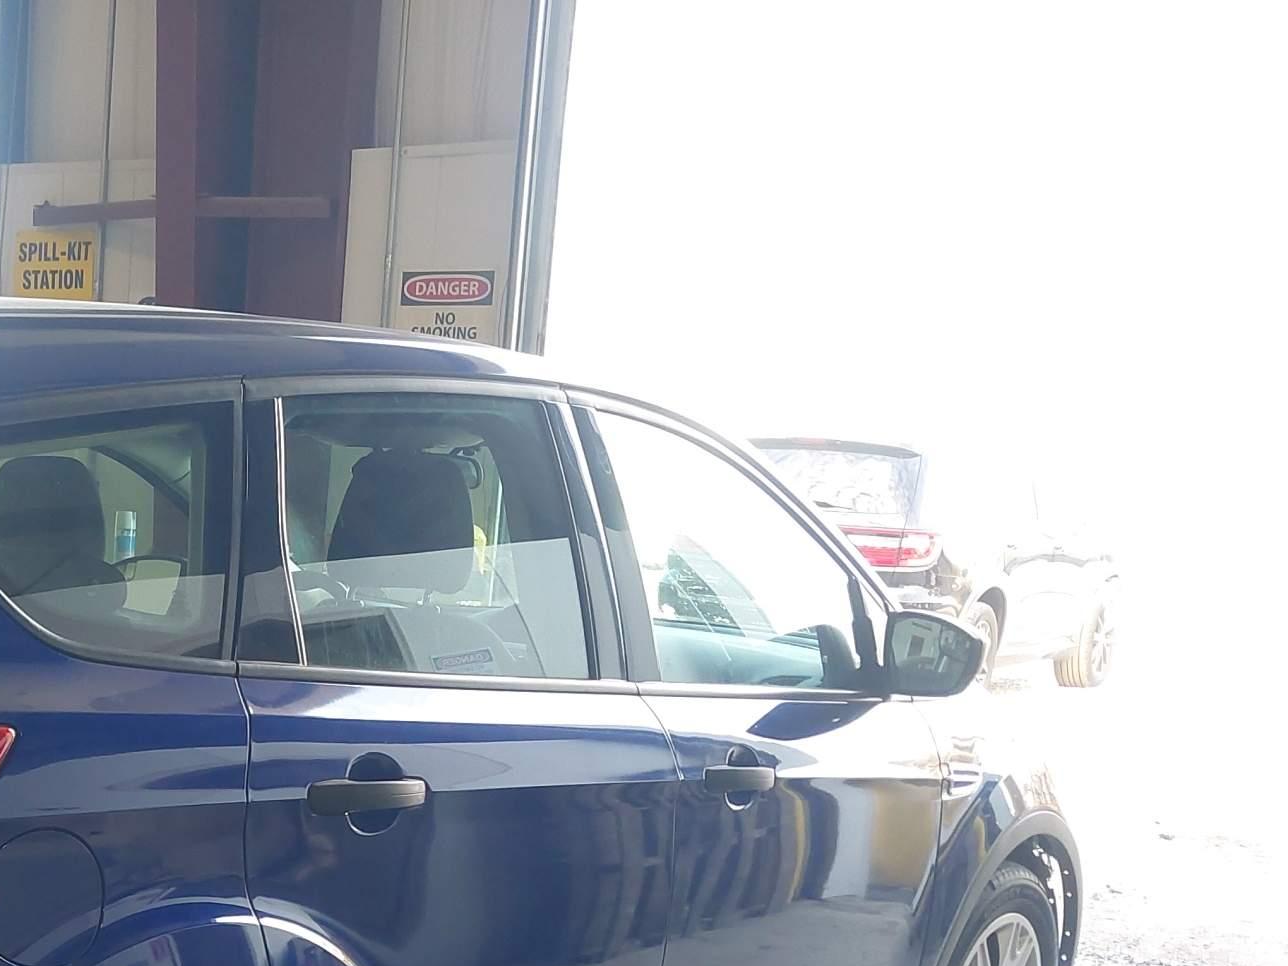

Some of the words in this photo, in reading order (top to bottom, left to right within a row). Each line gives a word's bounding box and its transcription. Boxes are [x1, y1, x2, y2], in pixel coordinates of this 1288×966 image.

[18, 241, 93, 262] SPILL-KIT
[22, 269, 84, 290] STATION
[415, 281, 479, 296] DANGER
[435, 311, 456, 325] NO
